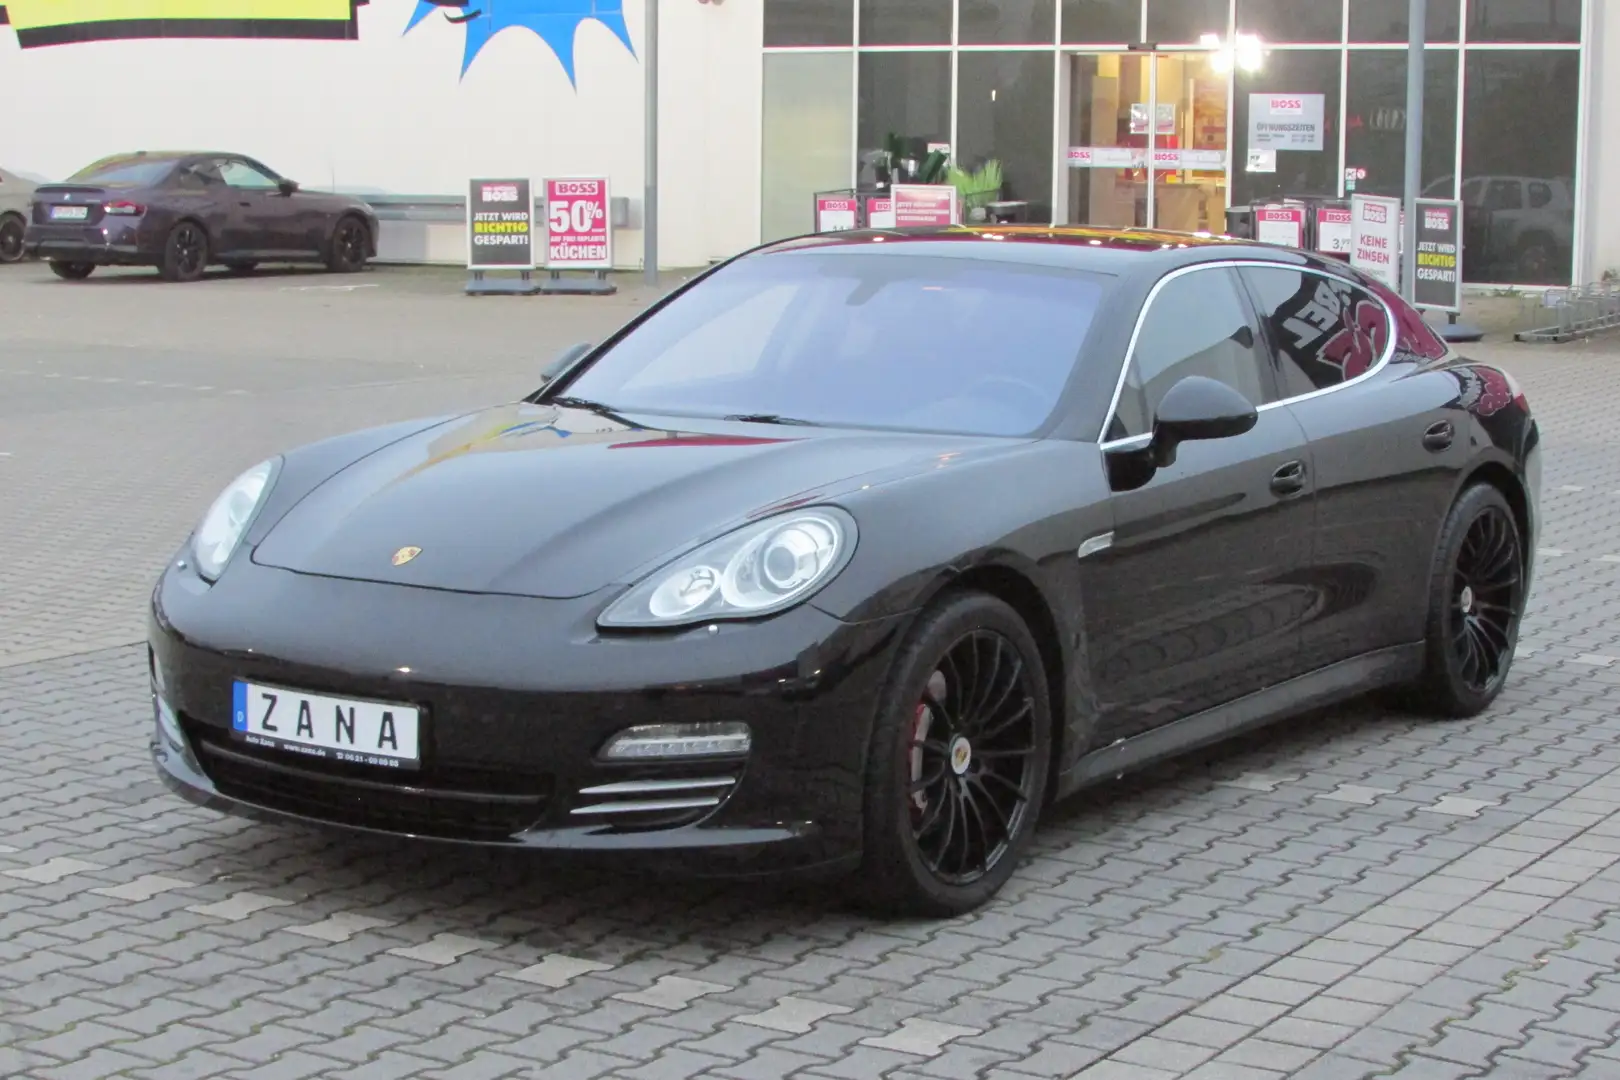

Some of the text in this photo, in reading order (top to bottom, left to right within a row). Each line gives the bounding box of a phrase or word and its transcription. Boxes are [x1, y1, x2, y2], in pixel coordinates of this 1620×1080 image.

[1271, 99, 1301, 109] BOSS
[1256, 122, 1315, 132] ÖFFNUNGSZEITEN
[1068, 151, 1090, 159] BOSS
[1155, 153, 1178, 161] BOSS
[558, 183, 596, 193] BOSS
[482, 191, 518, 202] BOSS
[474, 212, 528, 221] JETZT WIRD
[549, 199, 603, 233] 50%
[1267, 212, 1291, 220] BOSS
[1328, 214, 1352, 222] BOSS
[1364, 210, 1386, 222] BOSS
[474, 222, 528, 233] RICHTIG
[1424, 217, 1449, 230] BOSS
[474, 235, 528, 245] GESPART!
[1360, 234, 1388, 249] KEINE
[550, 243, 606, 259] KÜCHEN
[1417, 241, 1455, 254] JETZT WIRD
[1356, 248, 1390, 264] ZINSEN
[1417, 253, 1456, 267] RICHTIG
[1417, 268, 1455, 282] GESPART!
[236, 711, 244, 723] D
[245, 735, 259, 744] Auto
